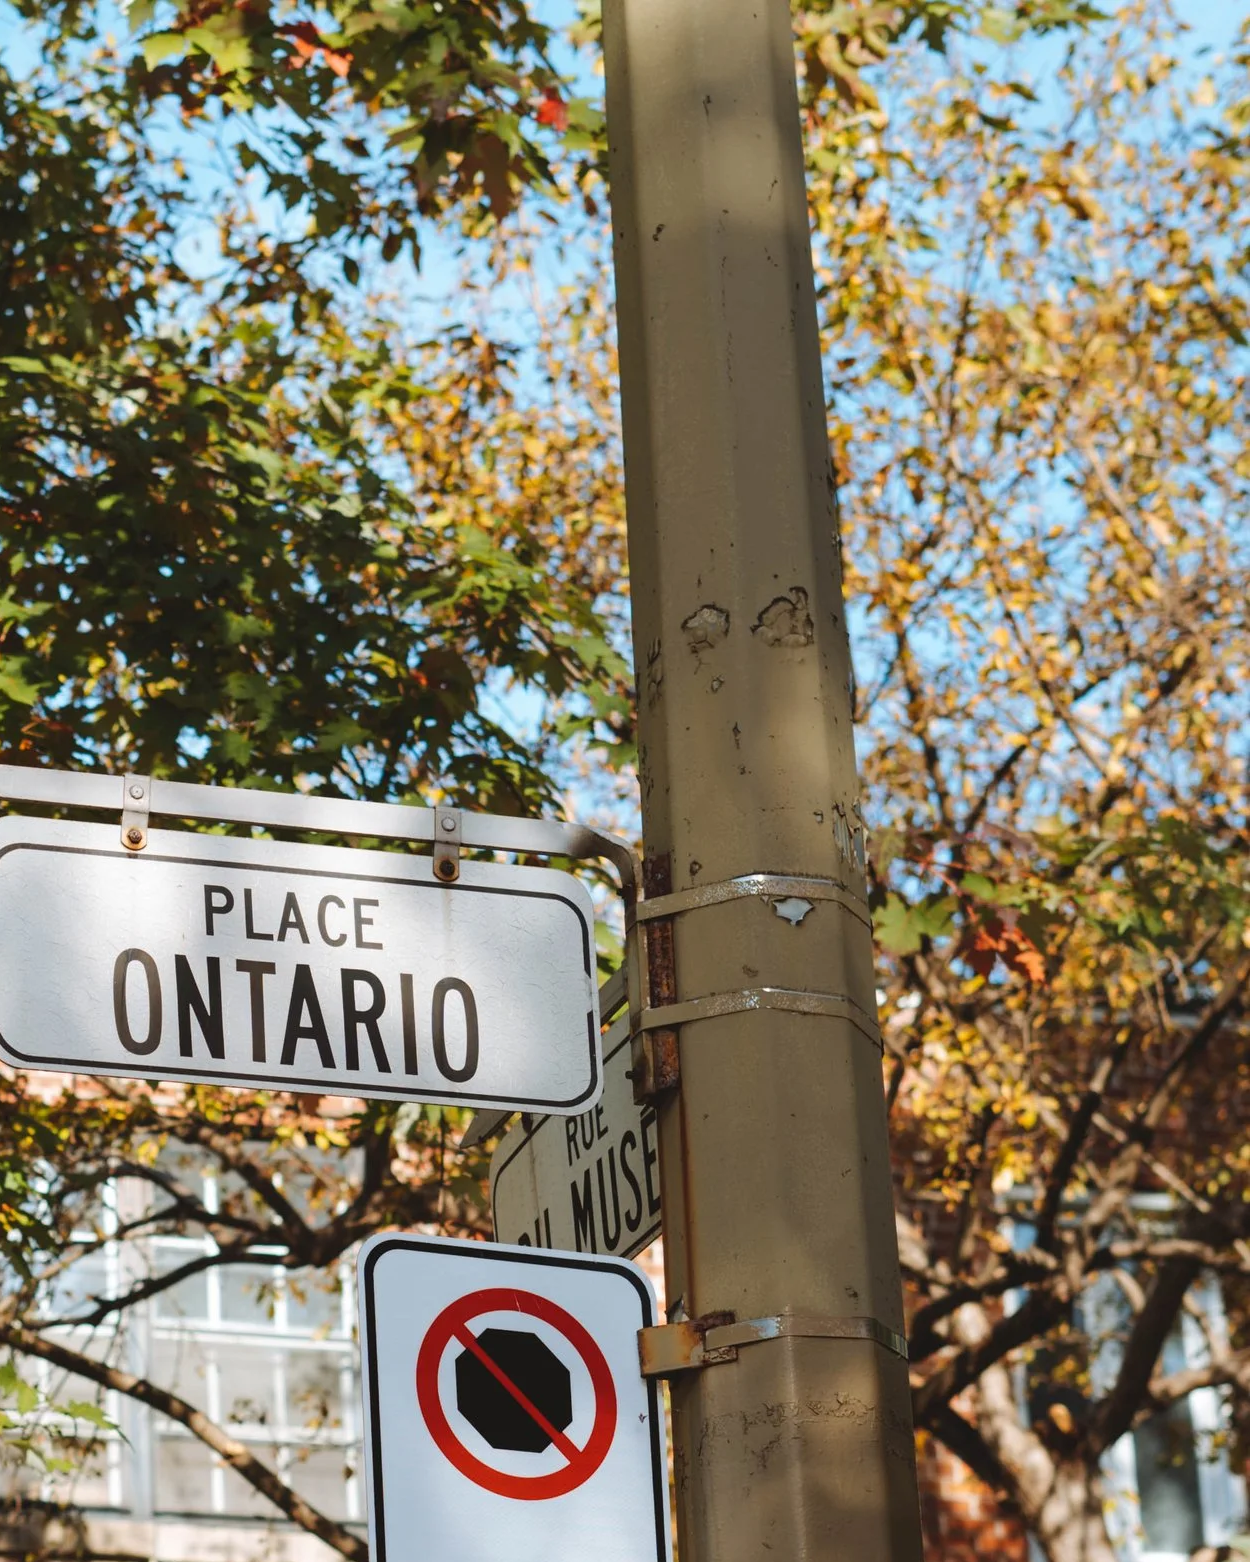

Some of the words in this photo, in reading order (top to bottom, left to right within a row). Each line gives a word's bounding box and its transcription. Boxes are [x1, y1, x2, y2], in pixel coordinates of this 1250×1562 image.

[204, 884, 383, 950] PLACE
[113, 948, 479, 1083] ONTARIO
[565, 1097, 608, 1167] RUE
